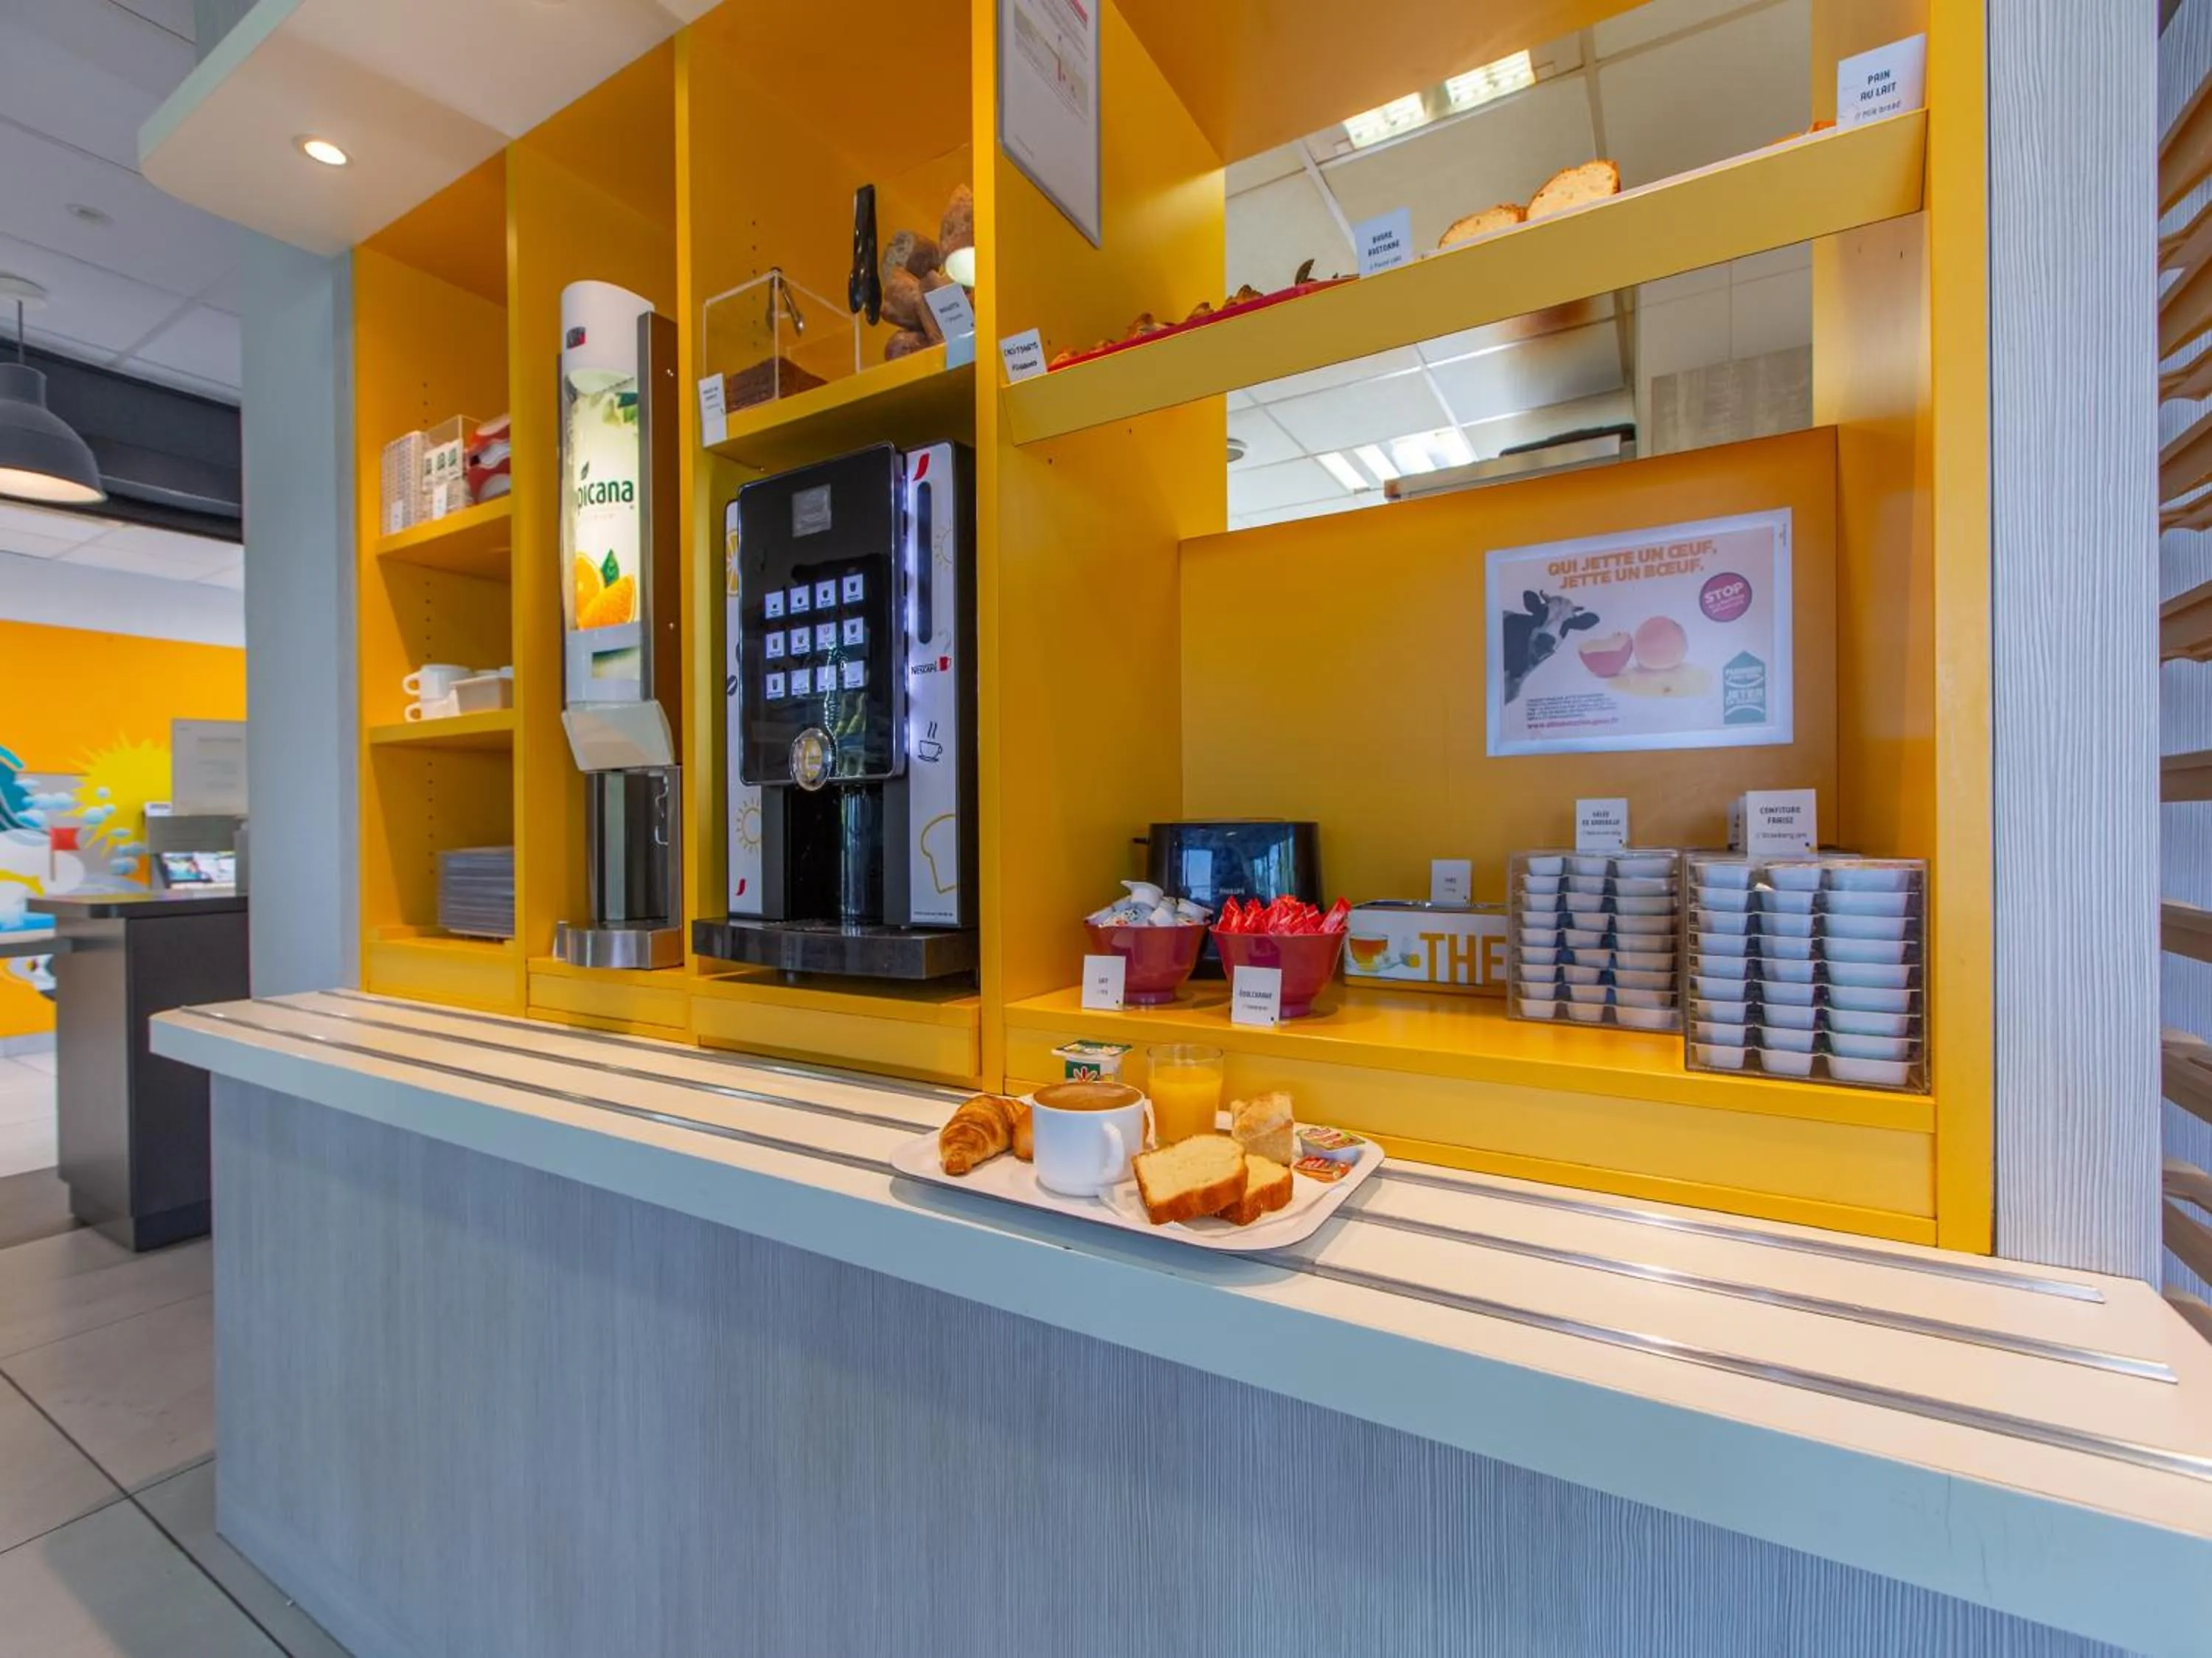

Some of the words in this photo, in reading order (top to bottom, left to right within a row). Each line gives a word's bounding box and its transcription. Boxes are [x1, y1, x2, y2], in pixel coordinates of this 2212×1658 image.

[1868, 69, 1891, 85] PAIN
[1860, 89, 1874, 102] AU
[1875, 82, 1897, 97] LAIT
[1548, 559, 1577, 576] QUI
[1581, 551, 1633, 572] JETTE
[1638, 547, 1664, 563] UN
[1559, 571, 1612, 589] JETTE
[1615, 566, 1641, 582] UN
[1704, 582, 1743, 604] STOP
[1759, 806, 1801, 814] CONFITURE
[1767, 816, 1793, 825] FRAISE
